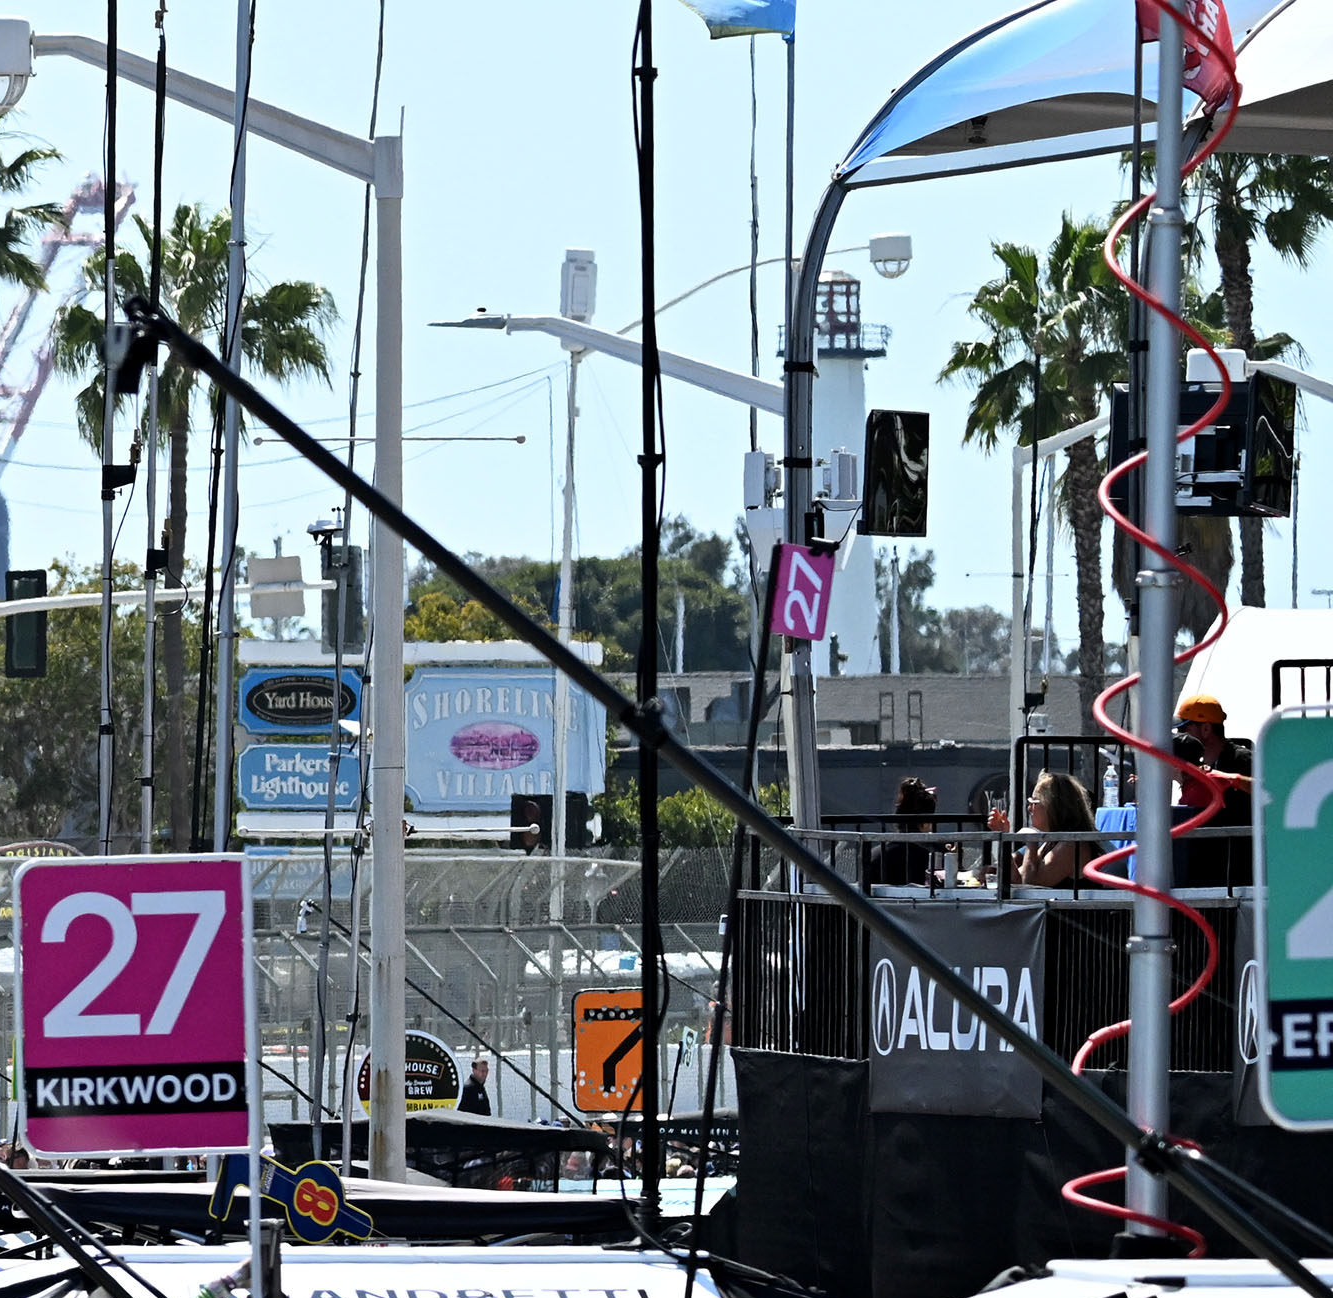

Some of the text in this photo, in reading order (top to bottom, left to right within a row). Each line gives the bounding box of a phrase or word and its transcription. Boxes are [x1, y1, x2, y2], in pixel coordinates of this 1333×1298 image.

[784, 551, 823, 634] 27
[264, 691, 342, 709] Yard Hous
[265, 752, 331, 777] Parkers
[40, 890, 226, 1038] 27
[897, 966, 1038, 1052] ACURA
[36, 1073, 237, 1107] KIRKWOOD
[408, 1086, 433, 1095] BREW
[294, 1178, 339, 1226] 8
